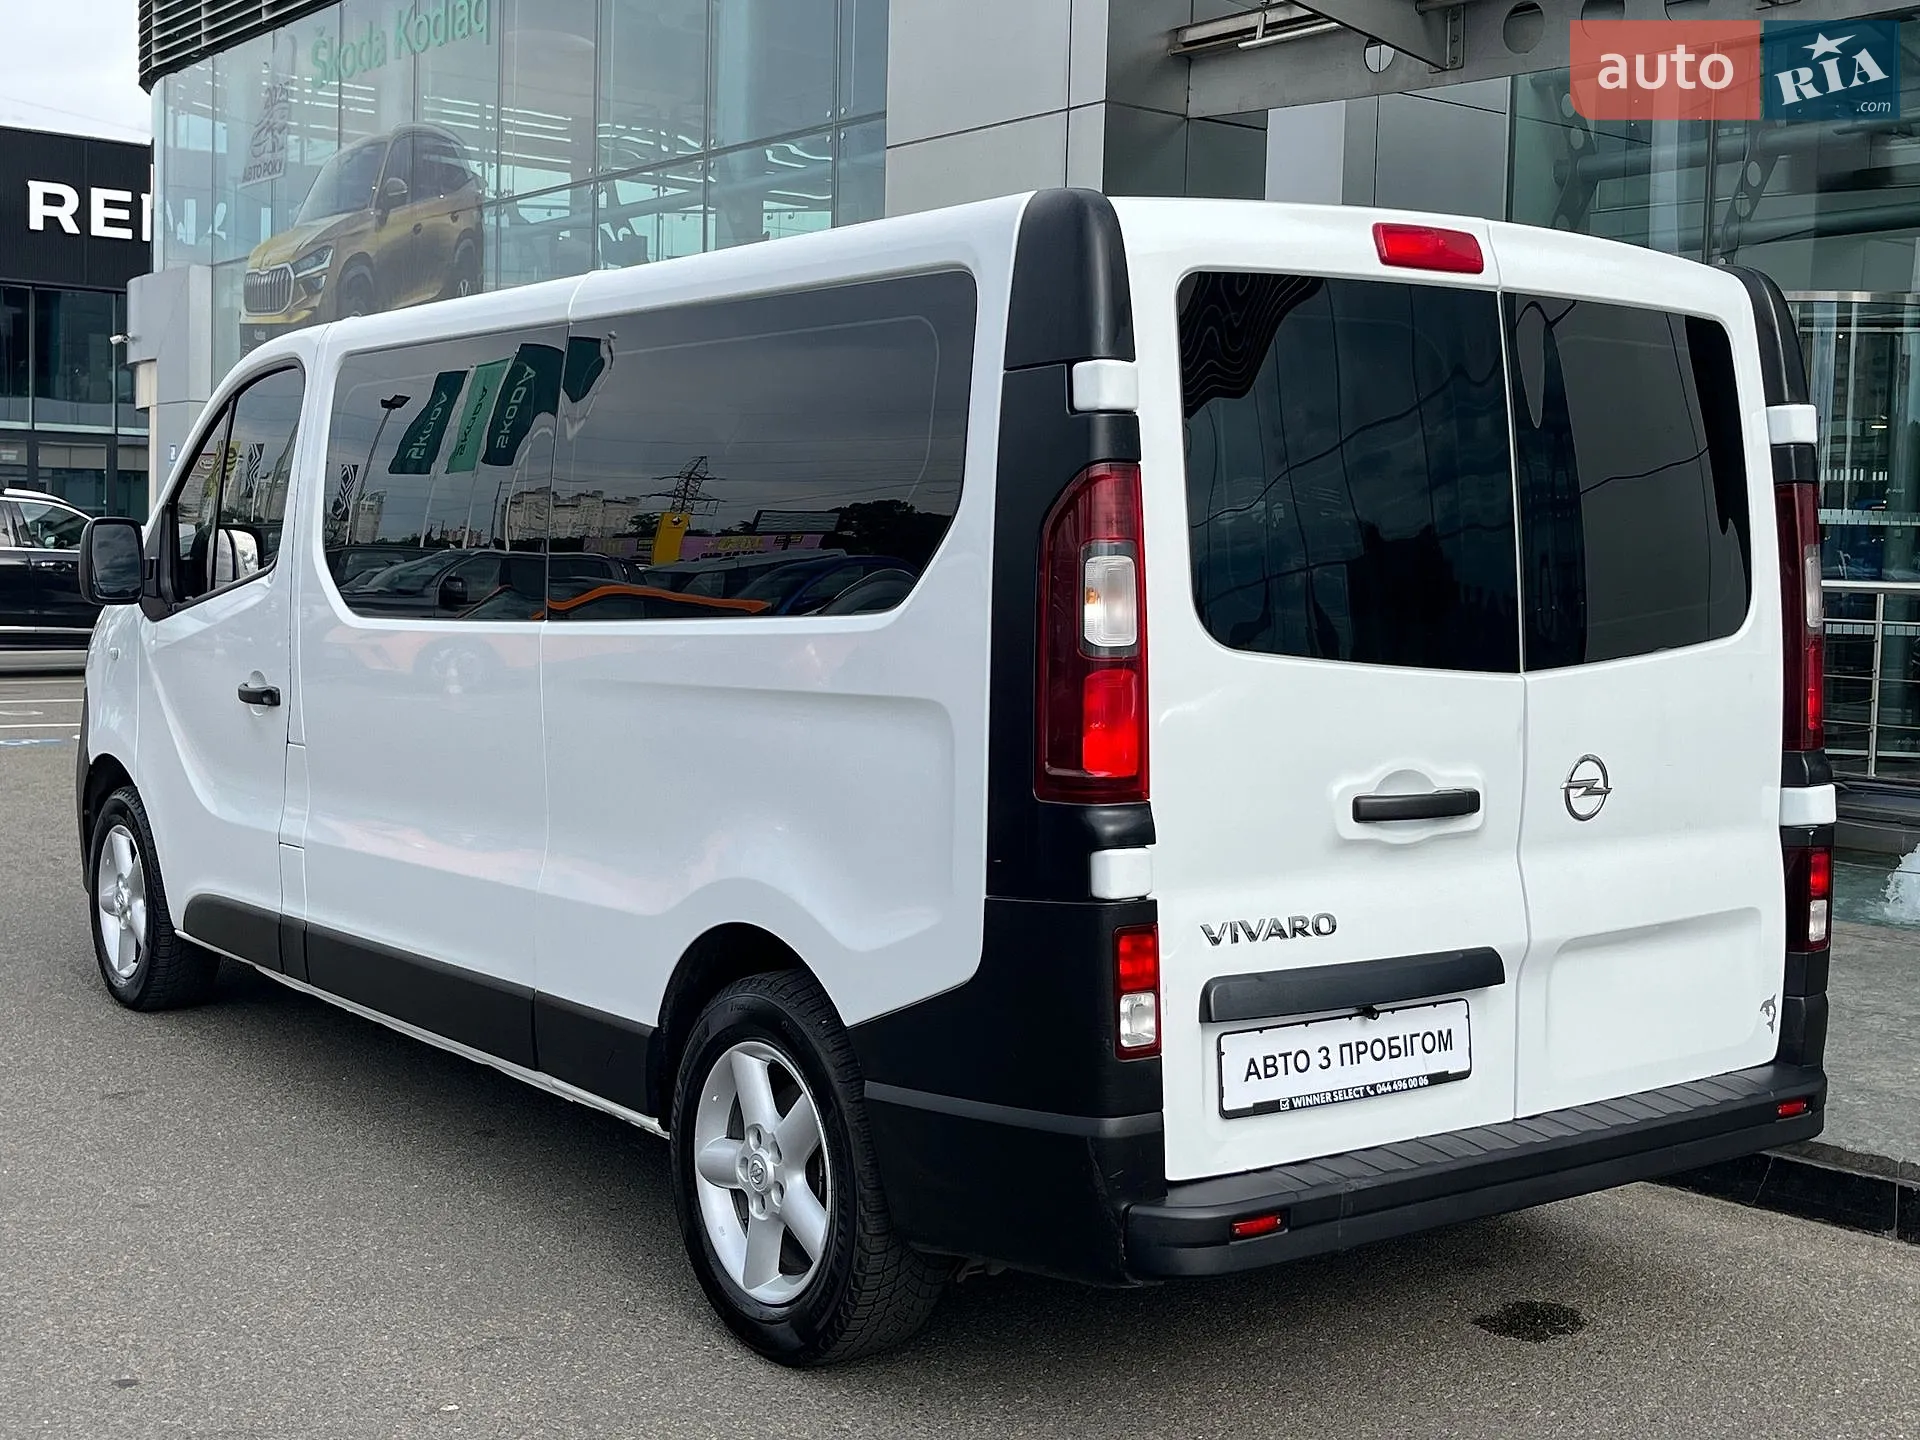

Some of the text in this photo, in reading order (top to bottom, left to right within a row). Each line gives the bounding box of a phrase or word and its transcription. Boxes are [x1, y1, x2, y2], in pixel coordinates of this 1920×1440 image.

[27, 179, 152, 242] RE
[1199, 912, 1337, 946] VIVARO
[1244, 1049, 1310, 1082] АВТО
[1338, 1028, 1453, 1067] ПРОБІГОМ
[1291, 1075, 1429, 1108] WINNER SELECT 044 496 00 06
